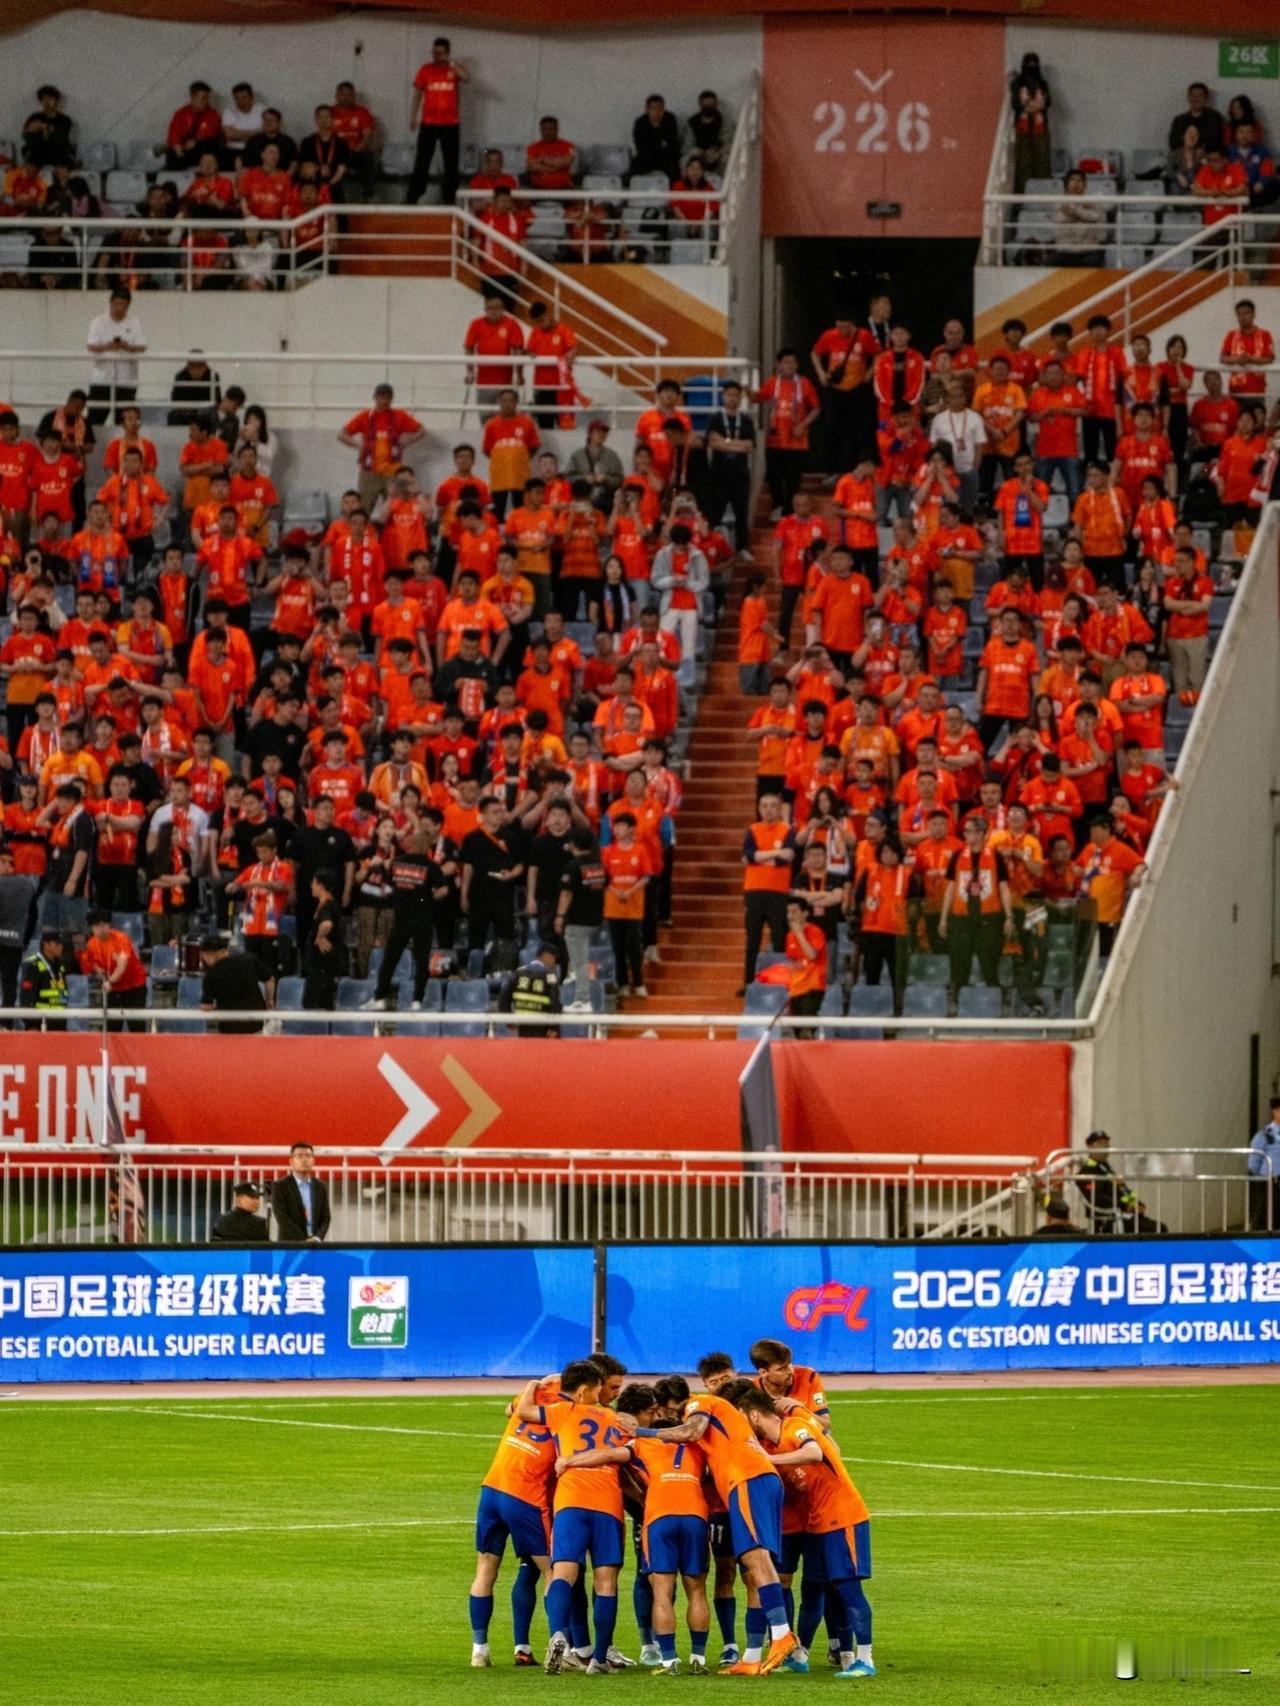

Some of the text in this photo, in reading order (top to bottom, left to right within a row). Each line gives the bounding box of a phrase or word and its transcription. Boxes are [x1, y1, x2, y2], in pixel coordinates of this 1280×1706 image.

[813, 101, 931, 153] 226
[892, 1270, 1001, 1309] 2026
[46, 1334, 160, 1358] FOOTBALL
[165, 1333, 235, 1357] SUPER
[241, 1332, 326, 1356] LEAGUE
[892, 1327, 943, 1350] 2026
[947, 1325, 1050, 1349] C'ESTBON
[1055, 1322, 1143, 1346] CHINESE
[1148, 1320, 1255, 1344] FOOTBALL
